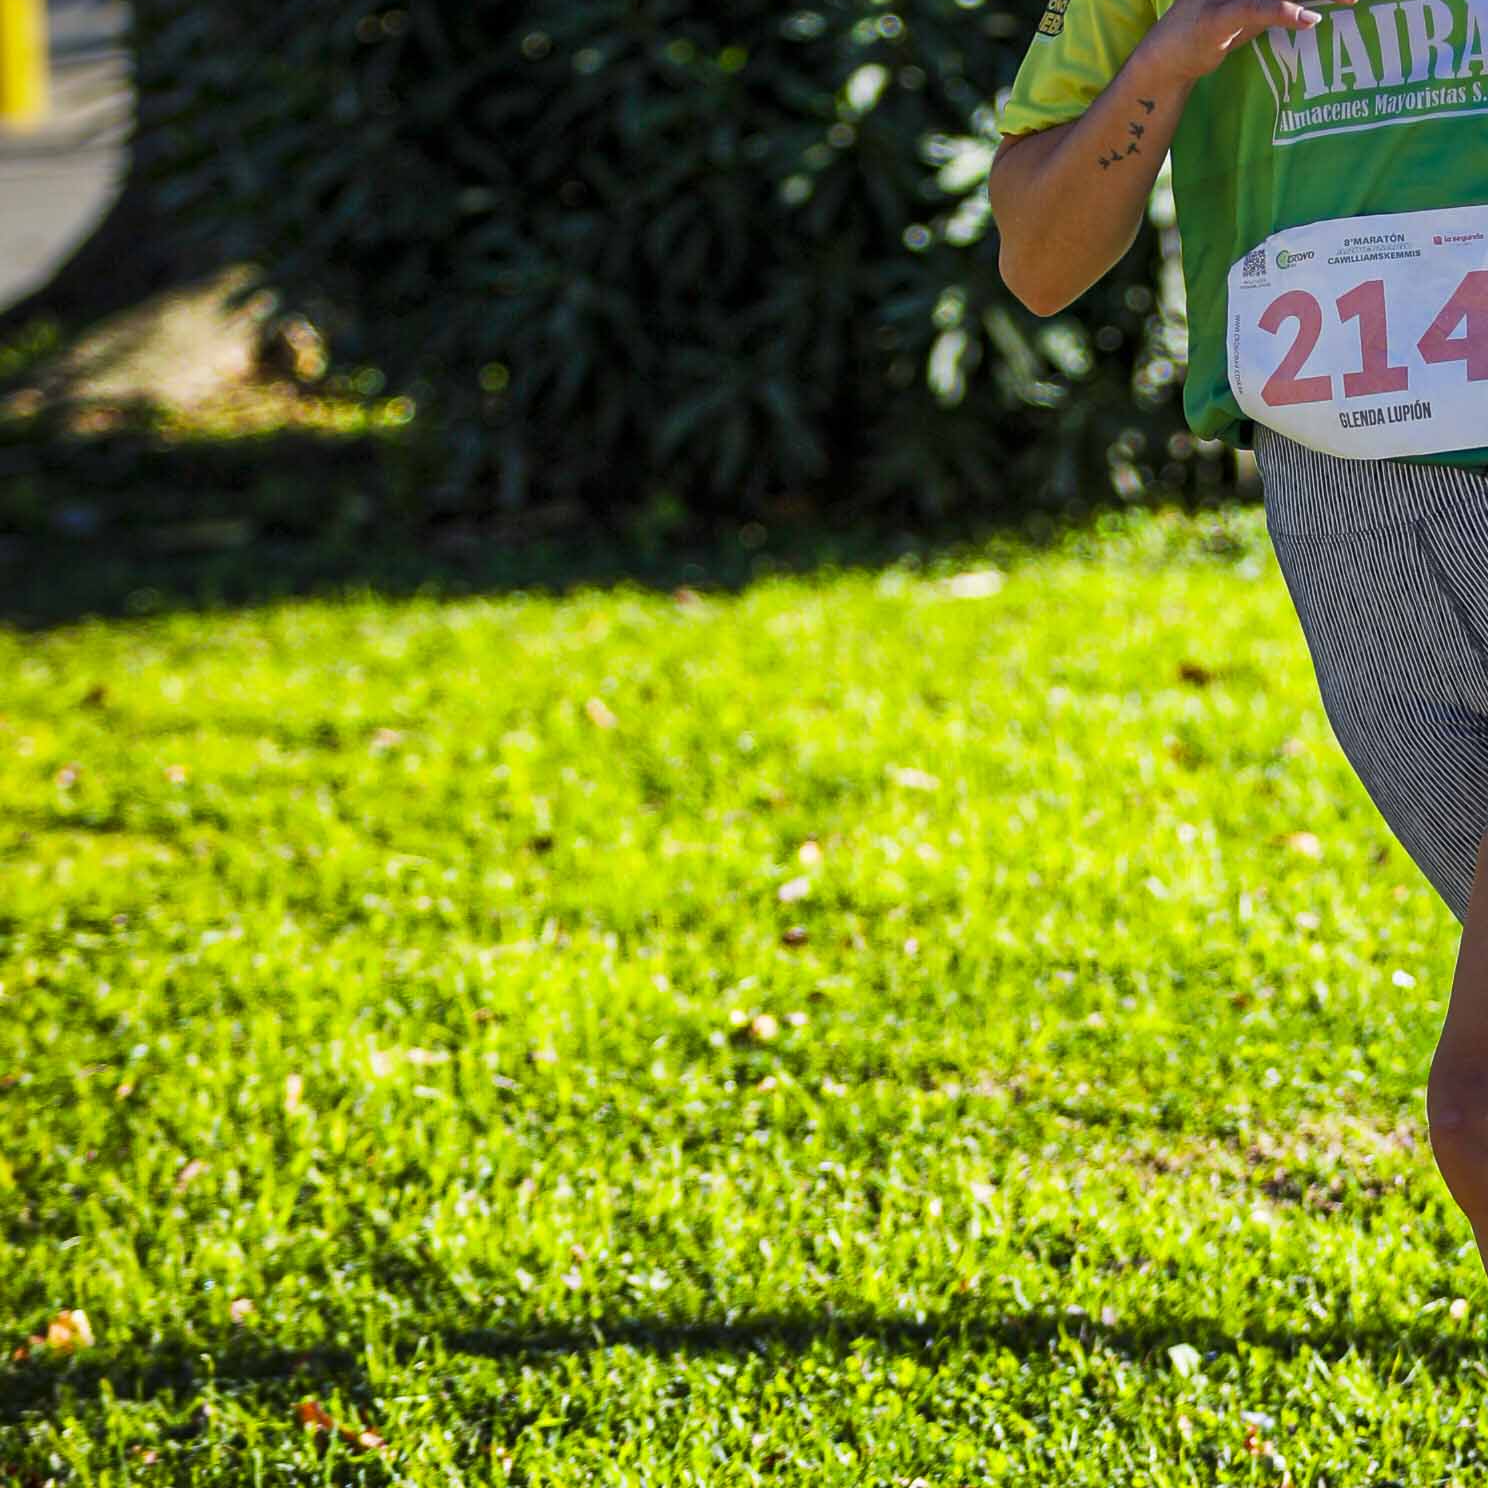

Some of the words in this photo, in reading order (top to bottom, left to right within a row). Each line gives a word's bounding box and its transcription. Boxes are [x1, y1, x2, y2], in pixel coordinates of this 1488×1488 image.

[1279, 96, 1369, 132] Almacenes
[1375, 85, 1466, 117] Mayoristas
[1327, 249, 1421, 265] CAWILLIAMSKEMMIS
[1339, 407, 1386, 429] GLENDA
[1387, 399, 1433, 424] LUPIÓN
